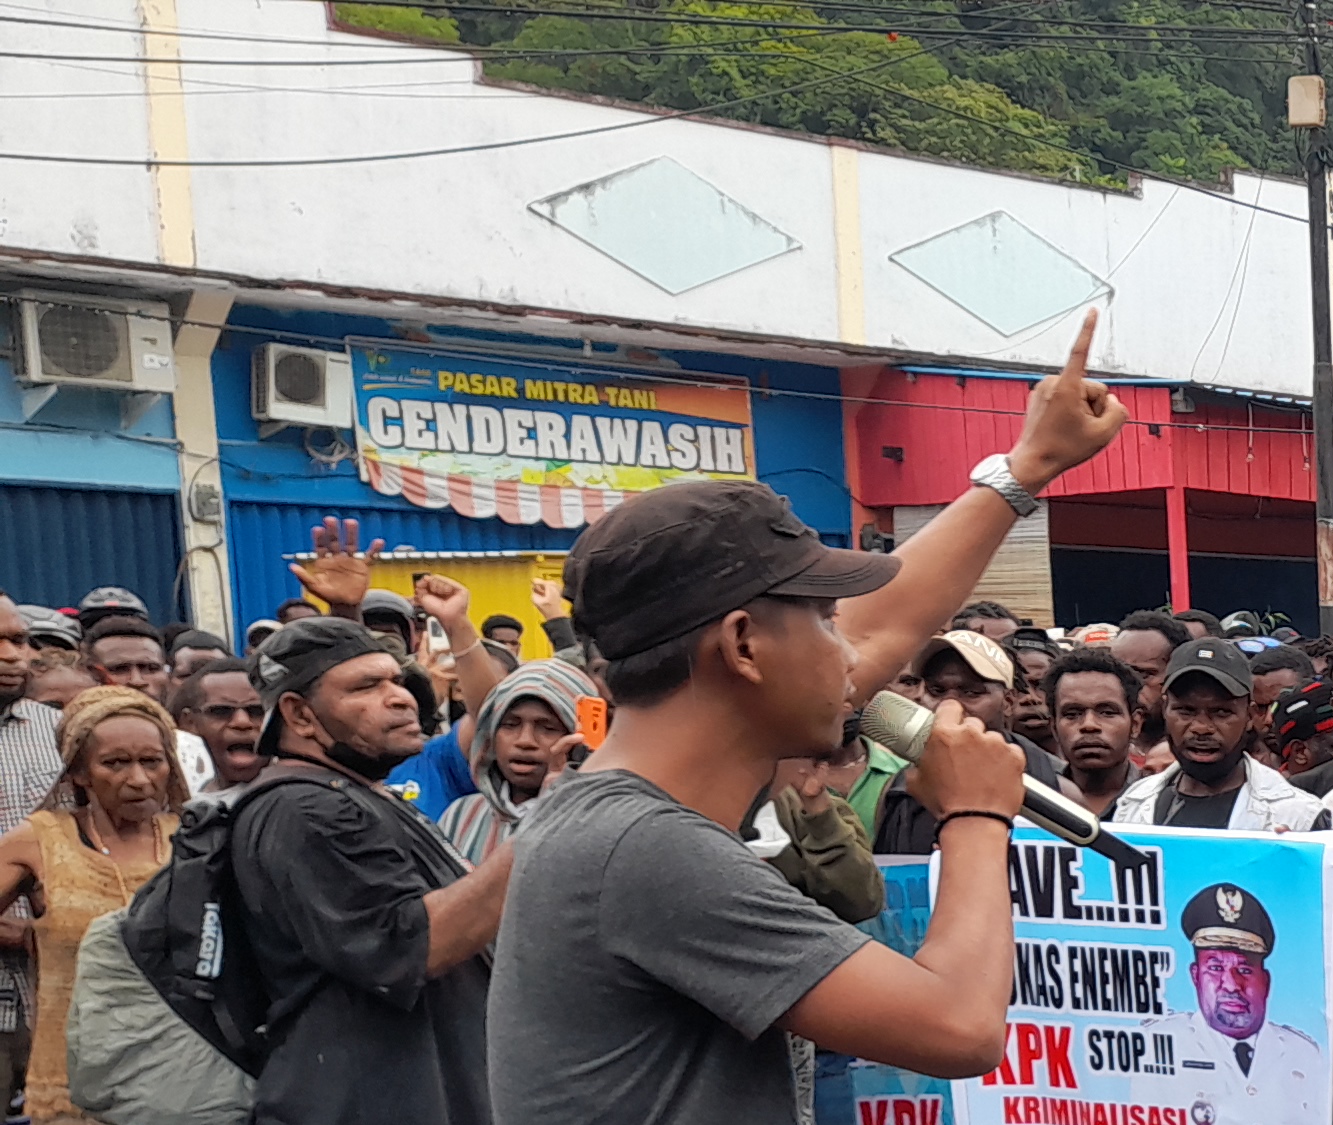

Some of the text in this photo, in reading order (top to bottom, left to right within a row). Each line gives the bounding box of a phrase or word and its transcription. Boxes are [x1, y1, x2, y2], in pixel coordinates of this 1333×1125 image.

[438, 371, 518, 398] PASAR
[525, 379, 599, 405] MITRA
[605, 386, 657, 410] TANI
[367, 397, 747, 473] CENDERAWASIH
[1008, 845, 1162, 924] AVE...!!!
[983, 1022, 1077, 1089] KPK
